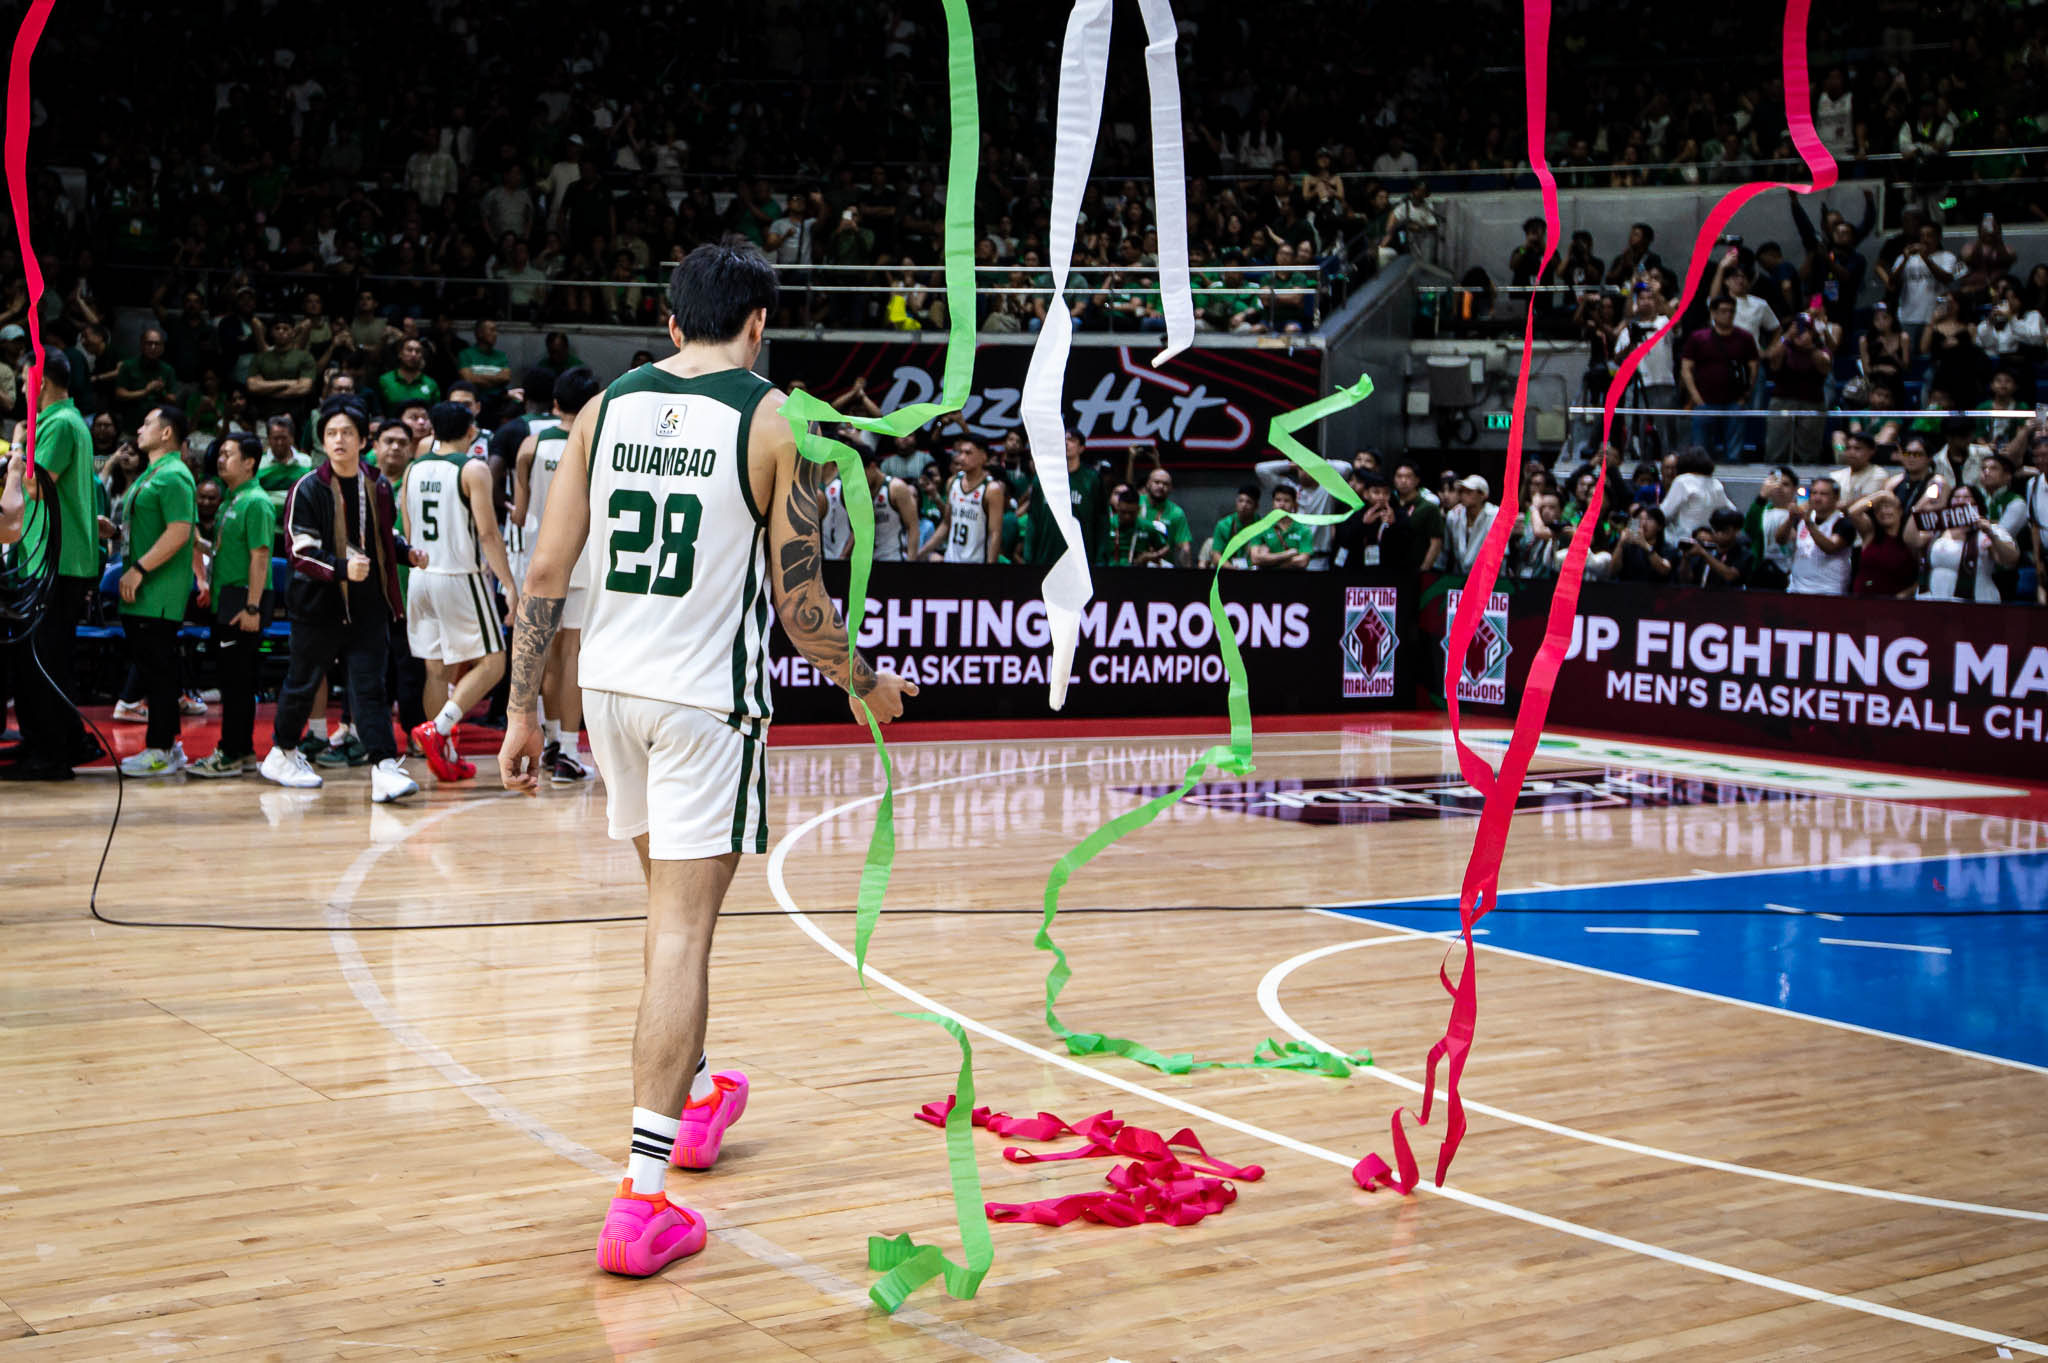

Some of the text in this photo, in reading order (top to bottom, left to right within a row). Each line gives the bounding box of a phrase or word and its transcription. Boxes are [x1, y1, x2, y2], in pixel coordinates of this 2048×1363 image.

[1073, 373, 1227, 442] Hut
[1488, 414, 1513, 430] EXI
[612, 443, 717, 477] QUIAMBAO
[422, 500, 439, 541] 5
[953, 523, 969, 546] 19
[1921, 512, 1939, 531] UP
[606, 489, 704, 598] 28
[1346, 590, 1396, 607] FIGHTING
[1449, 593, 1508, 611] FIING
[829, 598, 1052, 649] GHTING
[876, 655, 1081, 686] BASKETBA
[1636, 619, 1930, 690] FIGHTING
[1457, 683, 1504, 701] AROONS
[1606, 670, 2048, 742] MEN'S BASKETBALL CH
